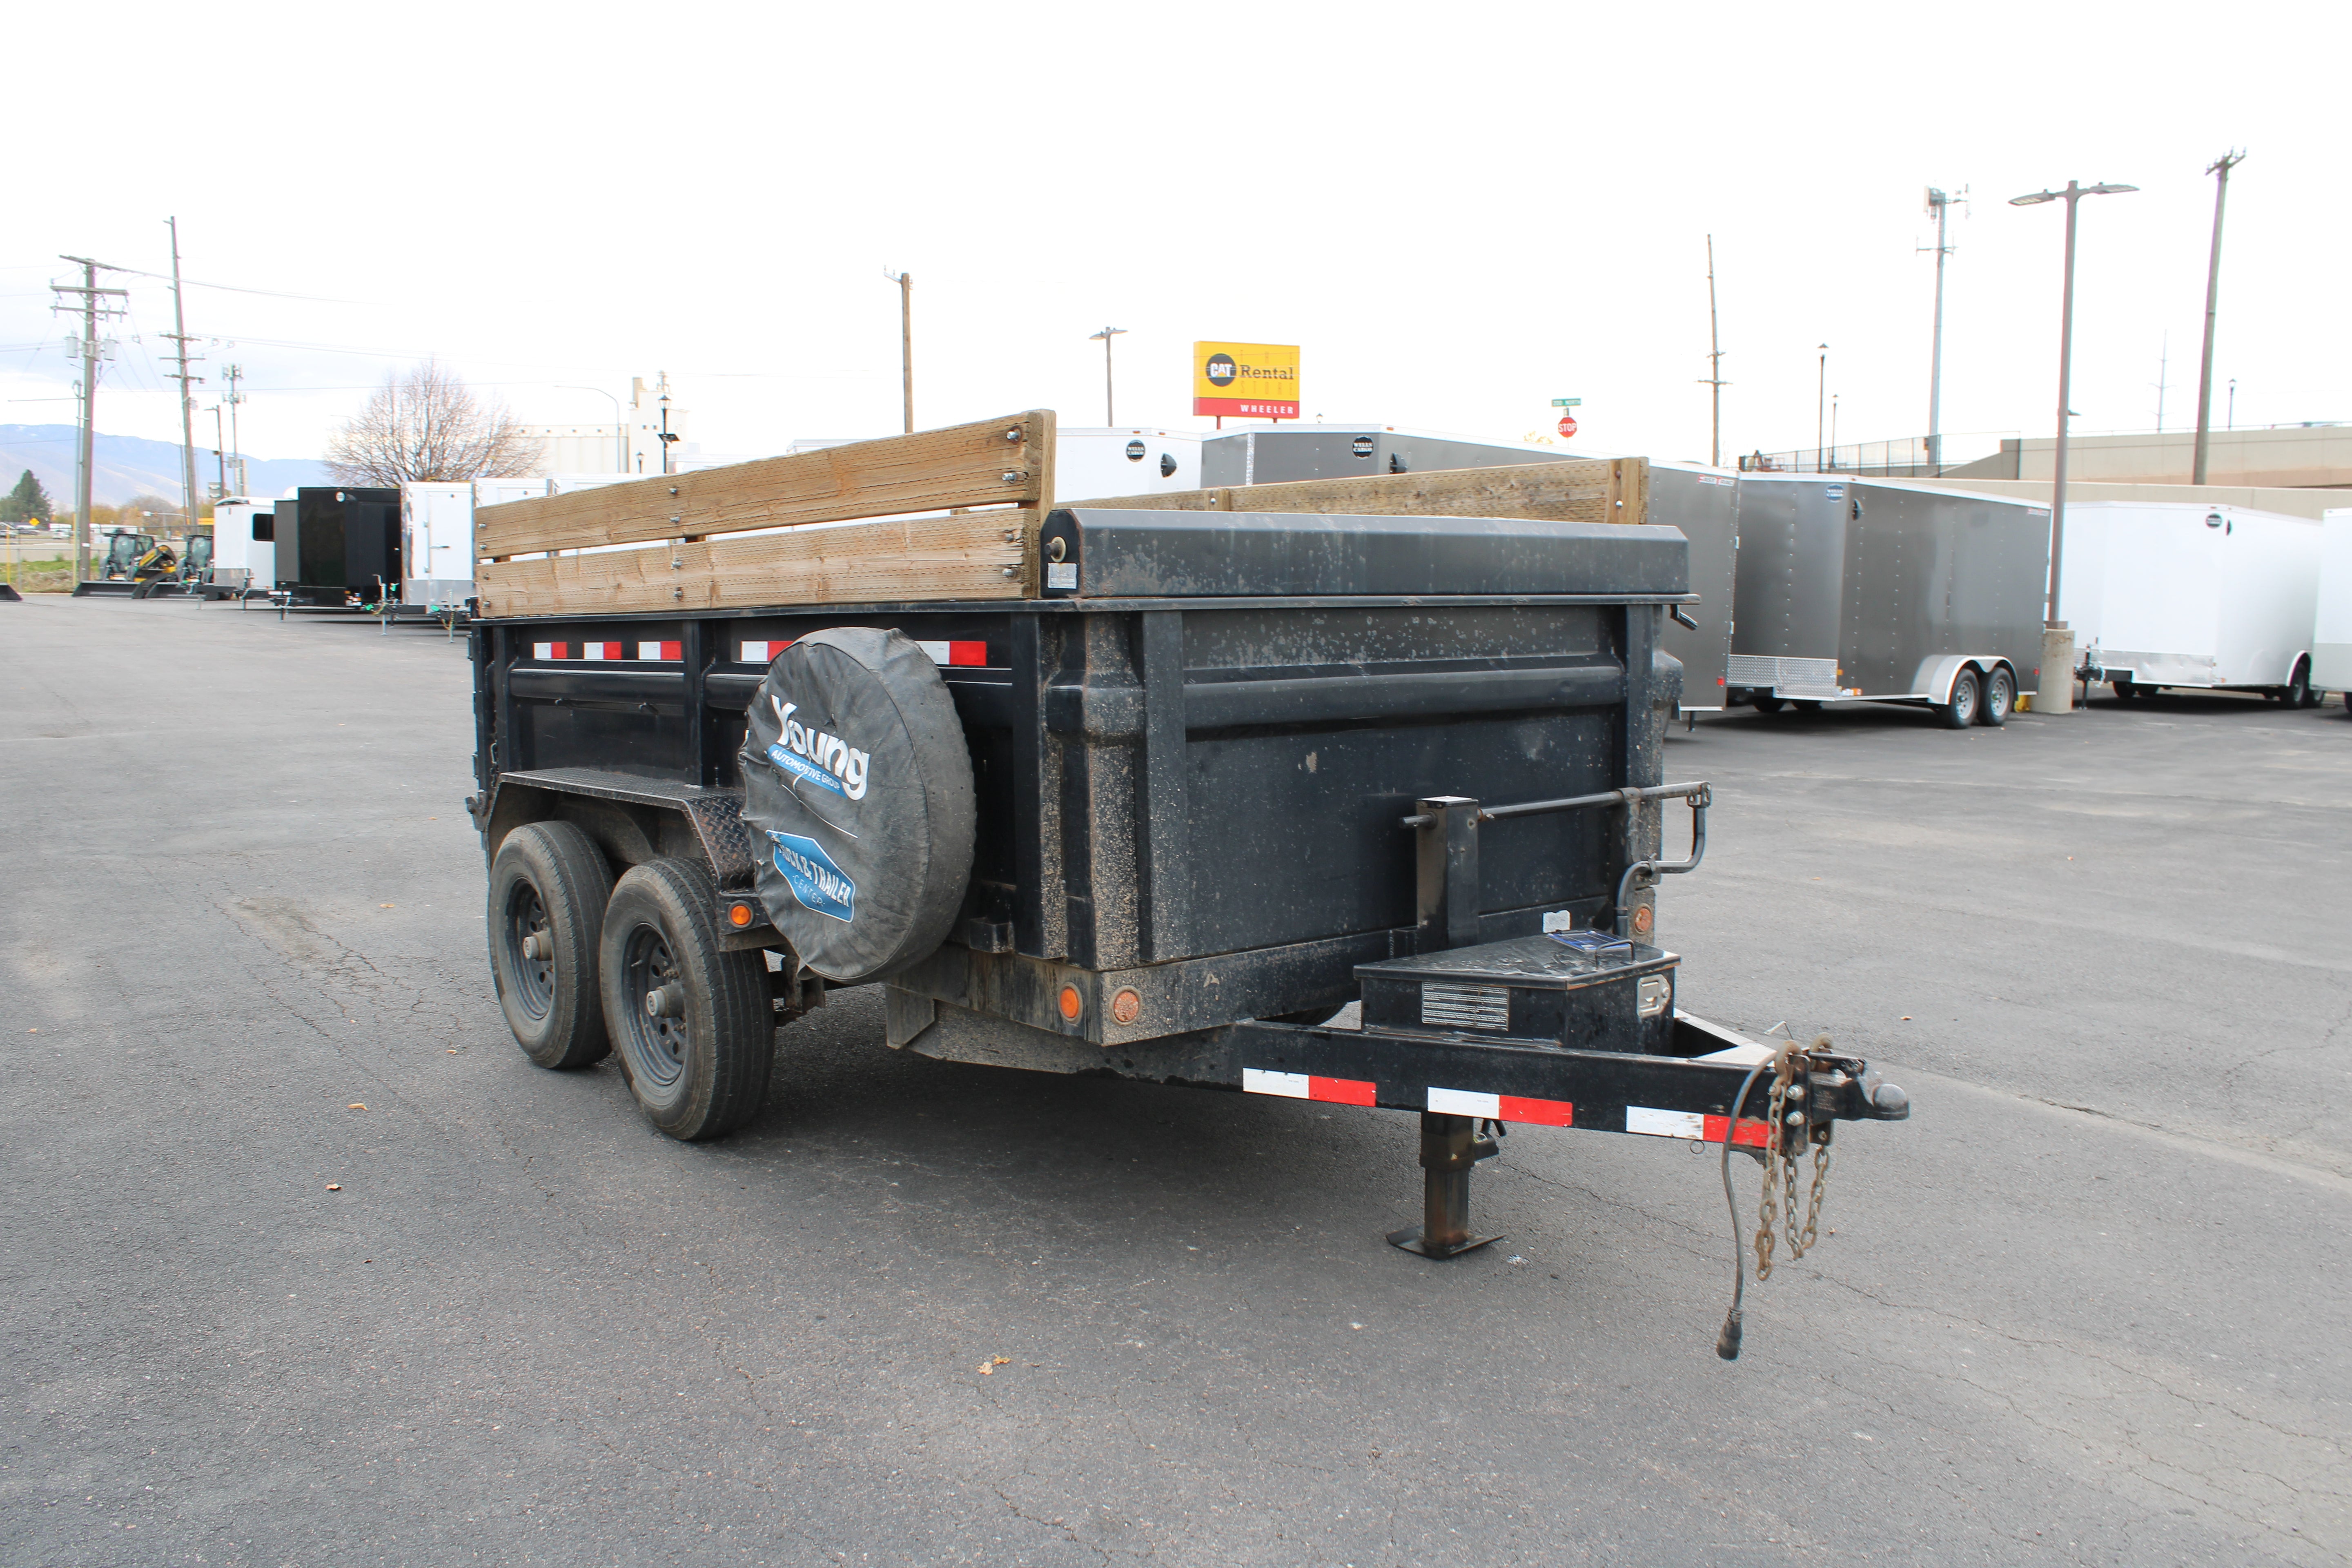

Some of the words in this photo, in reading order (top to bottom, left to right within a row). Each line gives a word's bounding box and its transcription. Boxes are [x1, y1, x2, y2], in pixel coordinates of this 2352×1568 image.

[1240, 349, 1293, 365] THE
[1210, 362, 1232, 377] CAT
[1240, 364, 1294, 380] Rental
[1241, 380, 1294, 395] STORE
[1240, 404, 1294, 414] WHEELER
[1559, 422, 1577, 432] STOP
[771, 694, 870, 800] Young
[771, 749, 821, 781] AUTOMOTIVE
[821, 773, 841, 790] GROUP
[793, 875, 824, 906] CENTER
[809, 860, 851, 907] TRAILER
